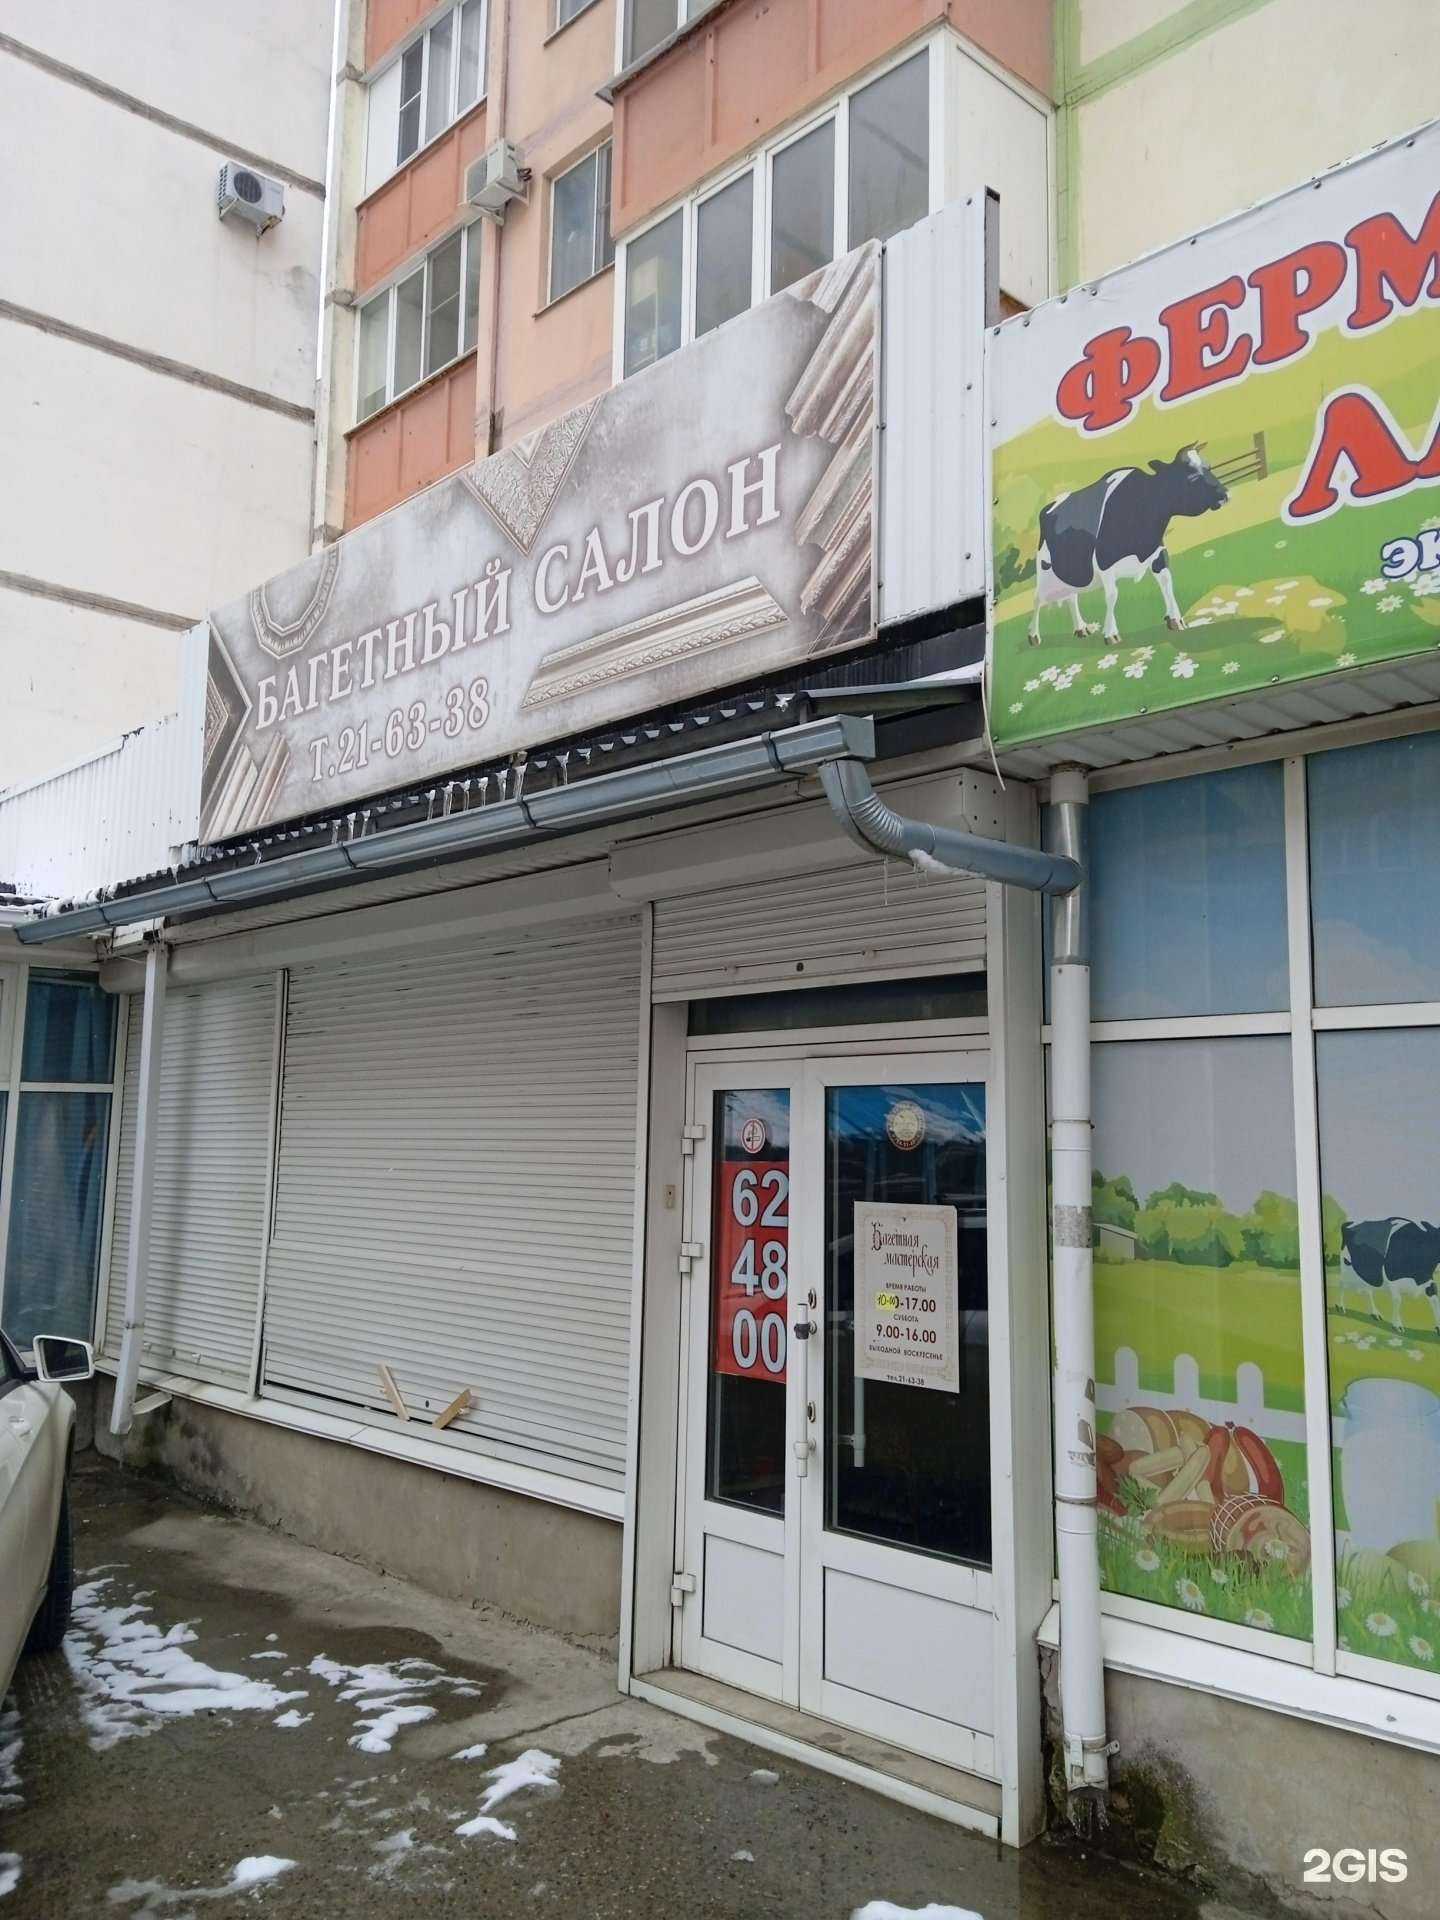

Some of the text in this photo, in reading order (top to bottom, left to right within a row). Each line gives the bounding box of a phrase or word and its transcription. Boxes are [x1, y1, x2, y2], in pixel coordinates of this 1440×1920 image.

[1288, 391, 1440, 518] Л
[256, 443, 782, 730] БАГЕТНЫЙ САЛОН
[732, 1169, 789, 1227] 62
[731, 1239, 788, 1300] 48
[732, 1308, 787, 1374] 00
[876, 1324, 937, 1343] 9.00-16.00
